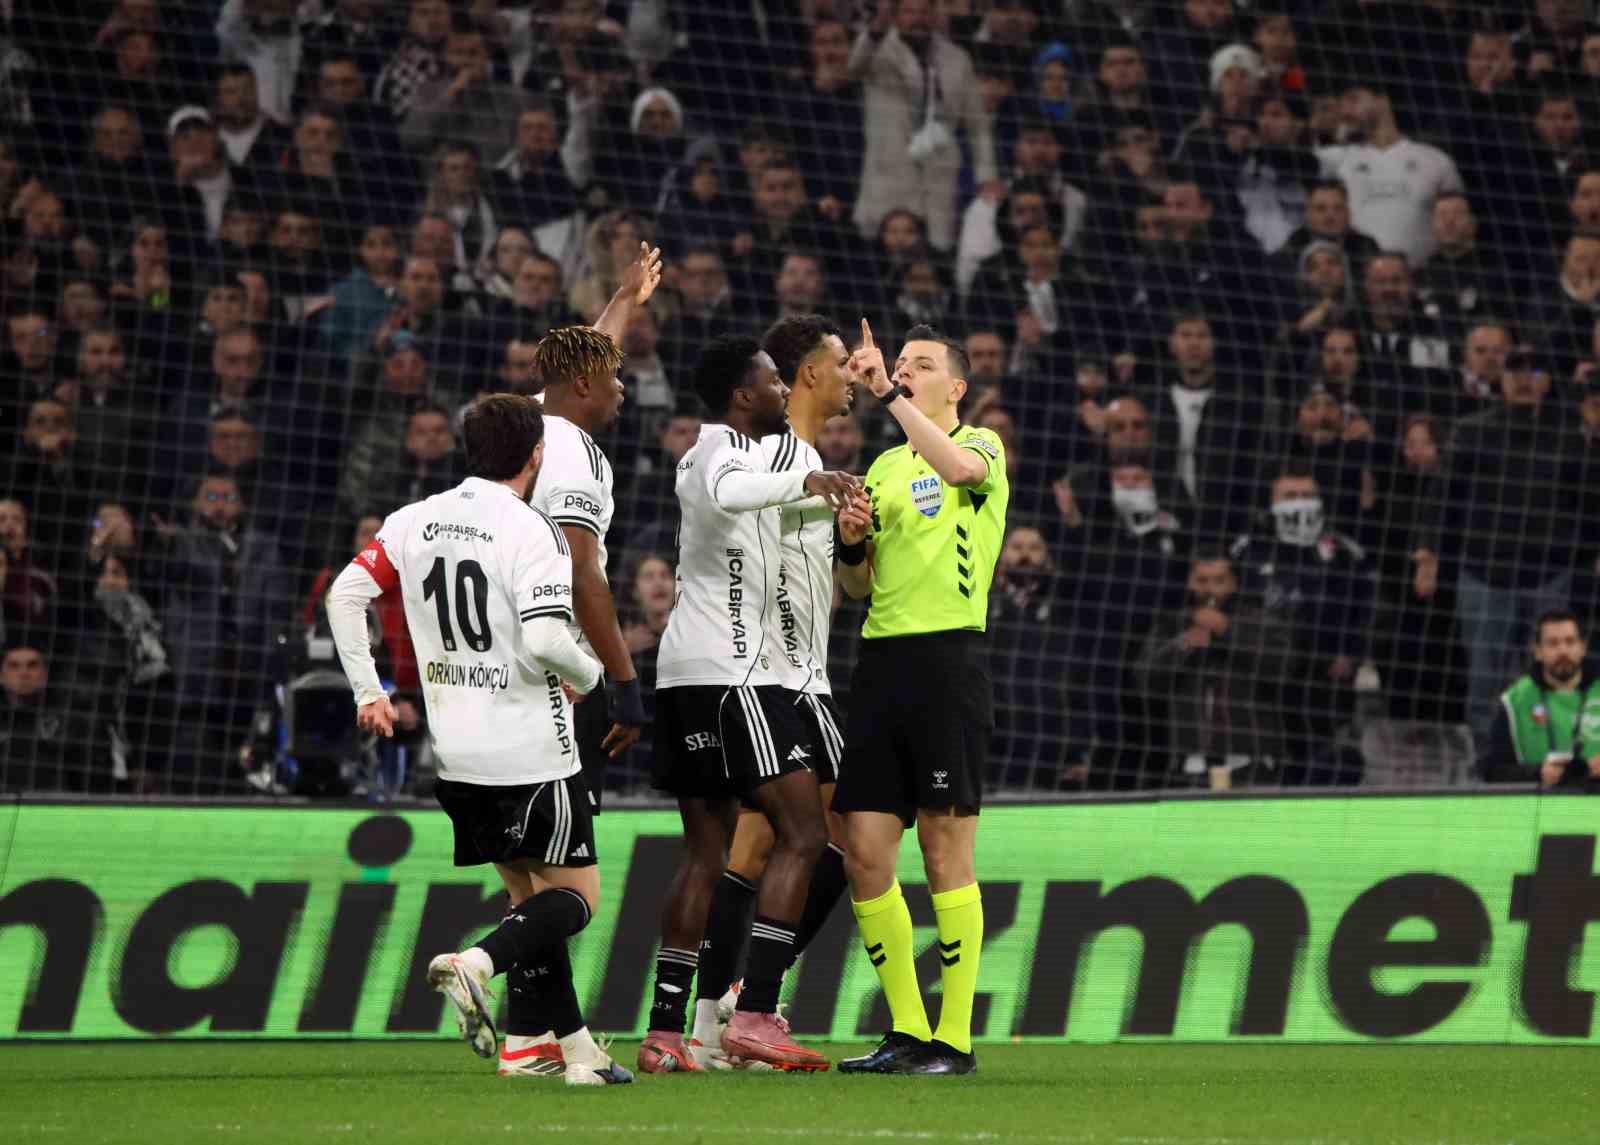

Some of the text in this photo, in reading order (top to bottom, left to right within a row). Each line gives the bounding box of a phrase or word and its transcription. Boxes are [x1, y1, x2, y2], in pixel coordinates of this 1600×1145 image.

[911, 478, 938, 493] FIFA
[422, 556, 493, 653] 10
[427, 661, 510, 695] ORKUN KÖKÇÜ
